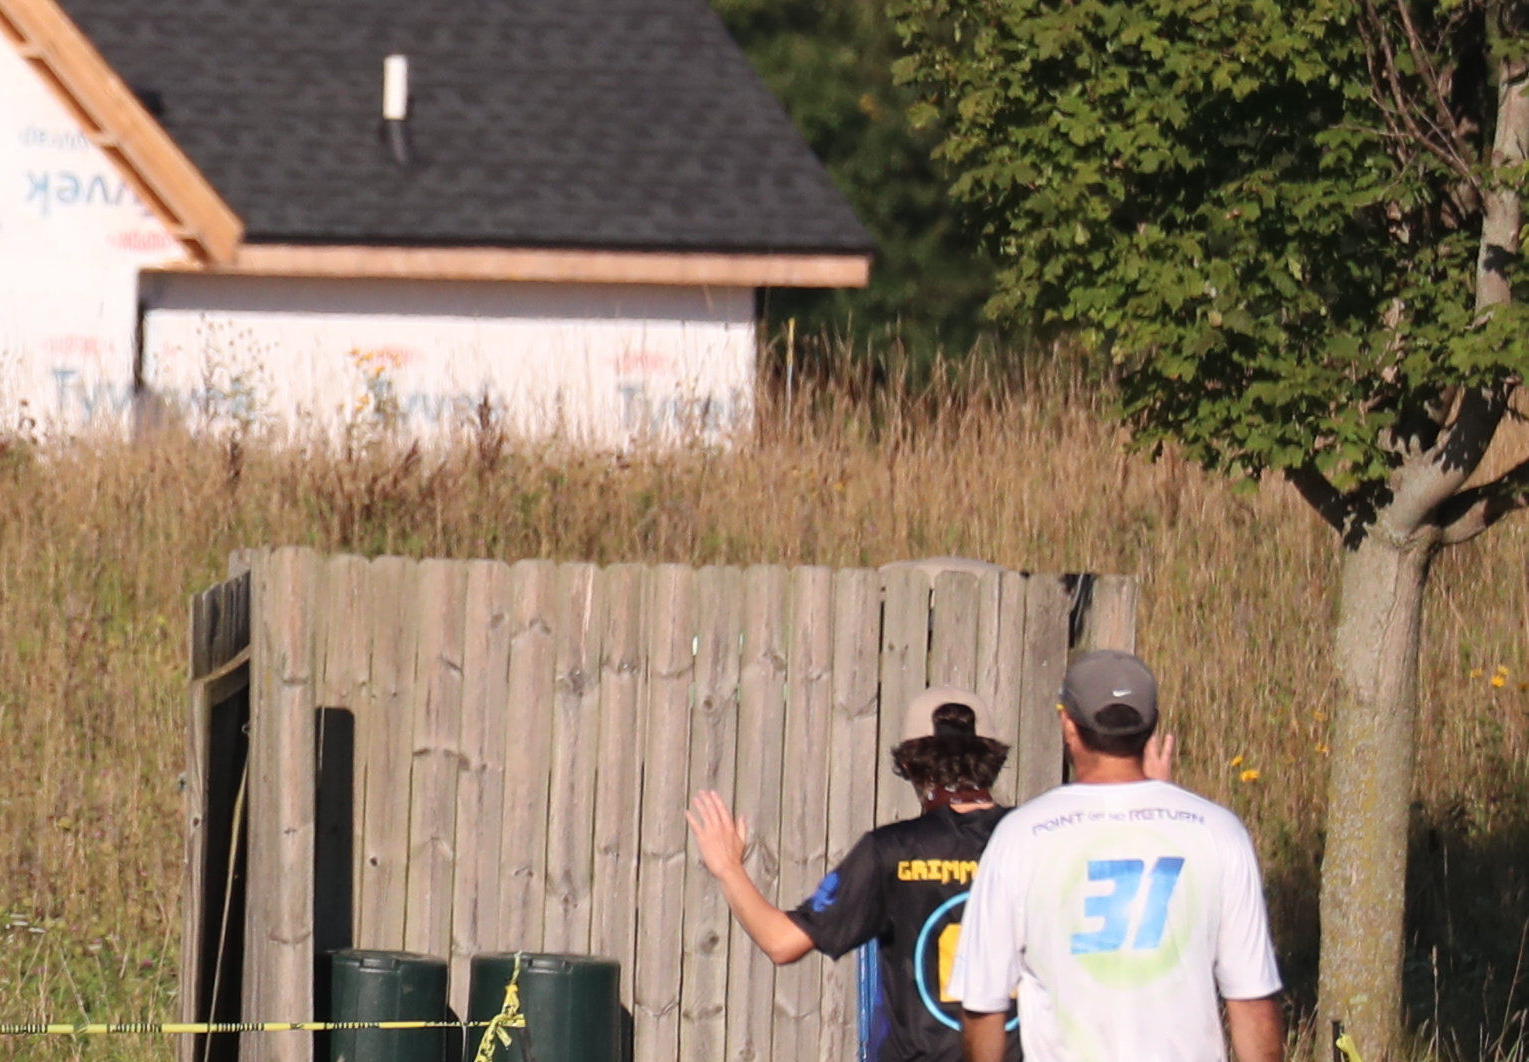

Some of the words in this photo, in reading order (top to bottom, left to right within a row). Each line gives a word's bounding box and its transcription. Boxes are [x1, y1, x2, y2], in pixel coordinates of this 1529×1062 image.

[1032, 811, 1084, 836] POINT
[1129, 808, 1206, 825] RETURN
[1070, 856, 1185, 955] 31
